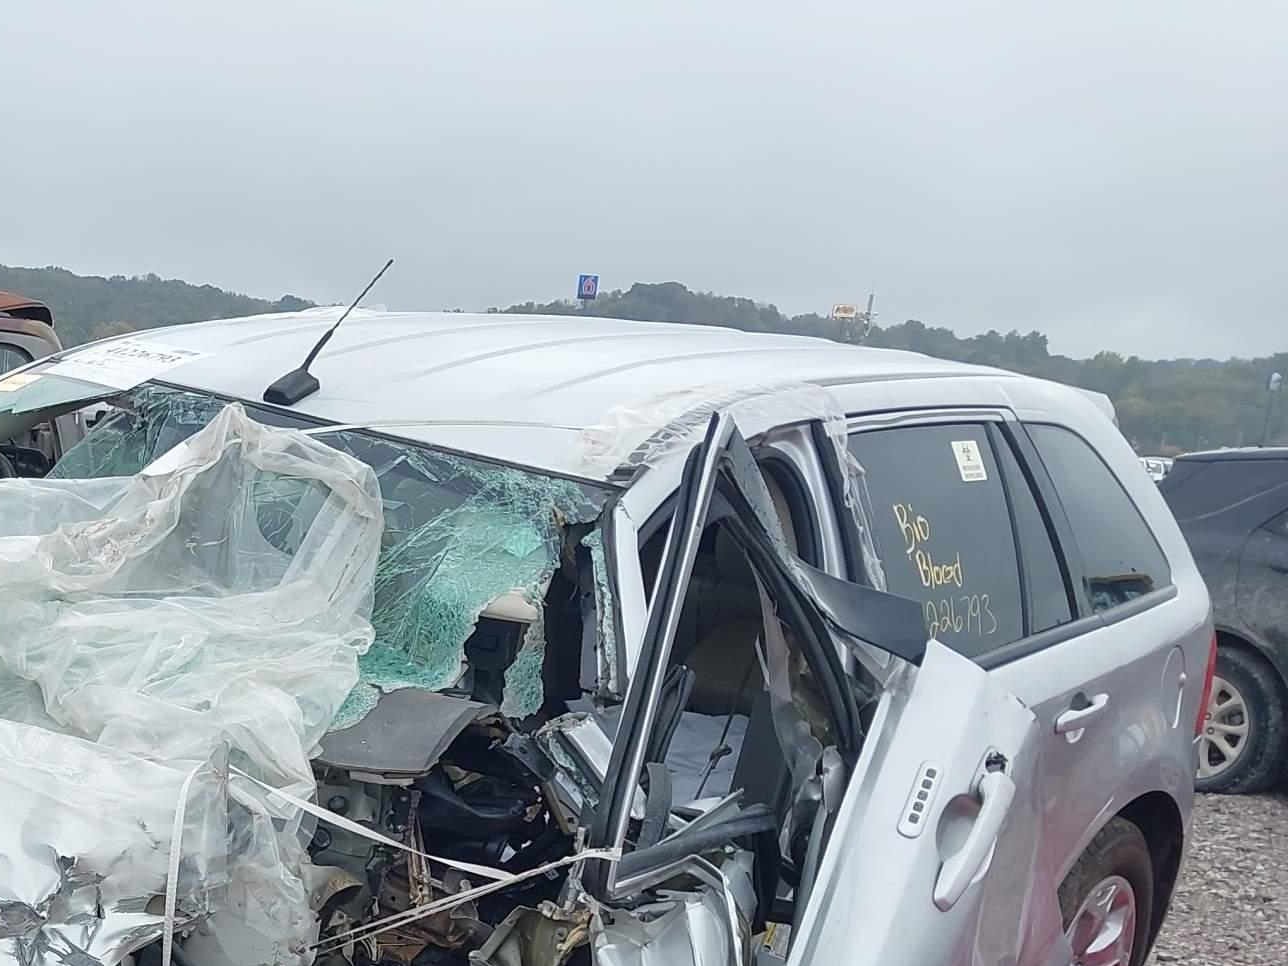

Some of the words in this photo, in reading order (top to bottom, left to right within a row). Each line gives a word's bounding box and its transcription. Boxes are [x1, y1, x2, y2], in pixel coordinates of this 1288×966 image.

[583, 276, 596, 296] 6
[892, 503, 930, 560] Bio
[924, 594, 997, 639] 226793
